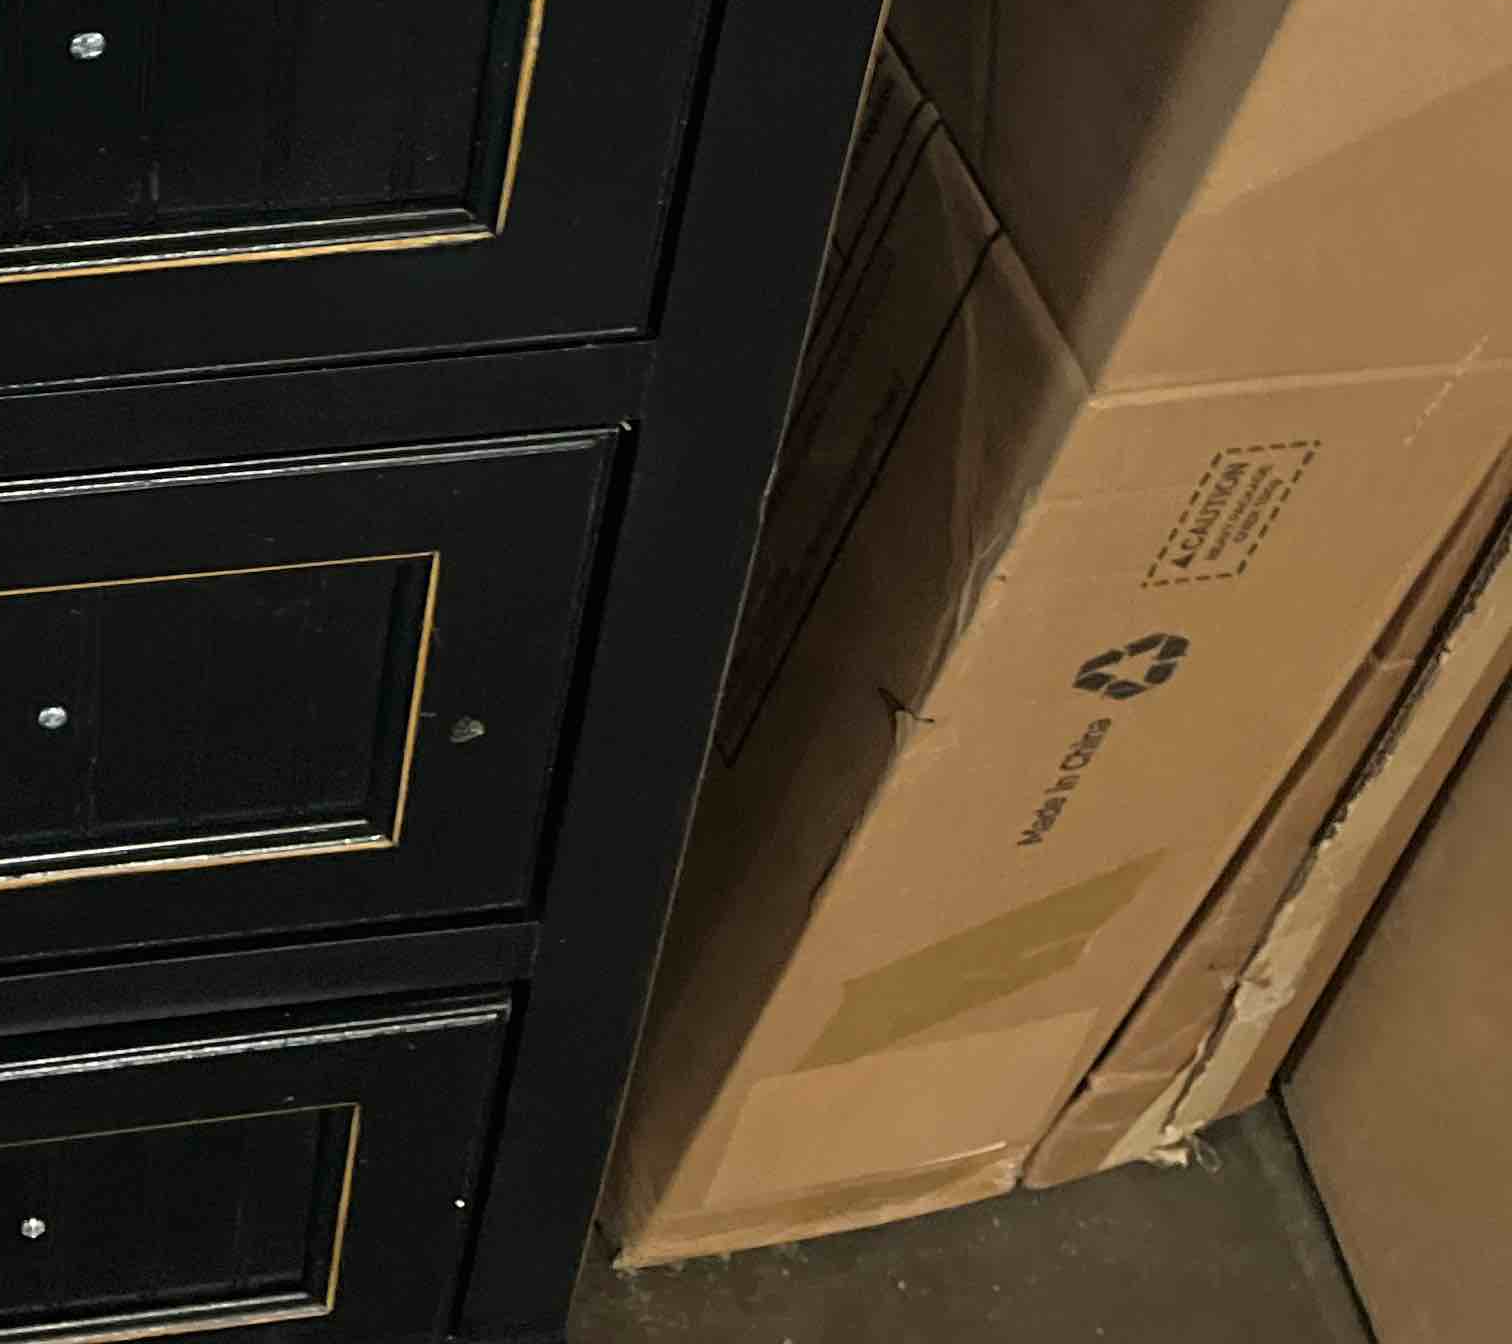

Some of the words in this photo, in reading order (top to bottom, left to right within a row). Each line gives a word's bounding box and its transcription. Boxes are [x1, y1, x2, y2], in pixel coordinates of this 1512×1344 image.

[1180, 462, 1251, 551] CAUTION
[1016, 797, 1067, 846] Made
[1059, 718, 1112, 771] China
